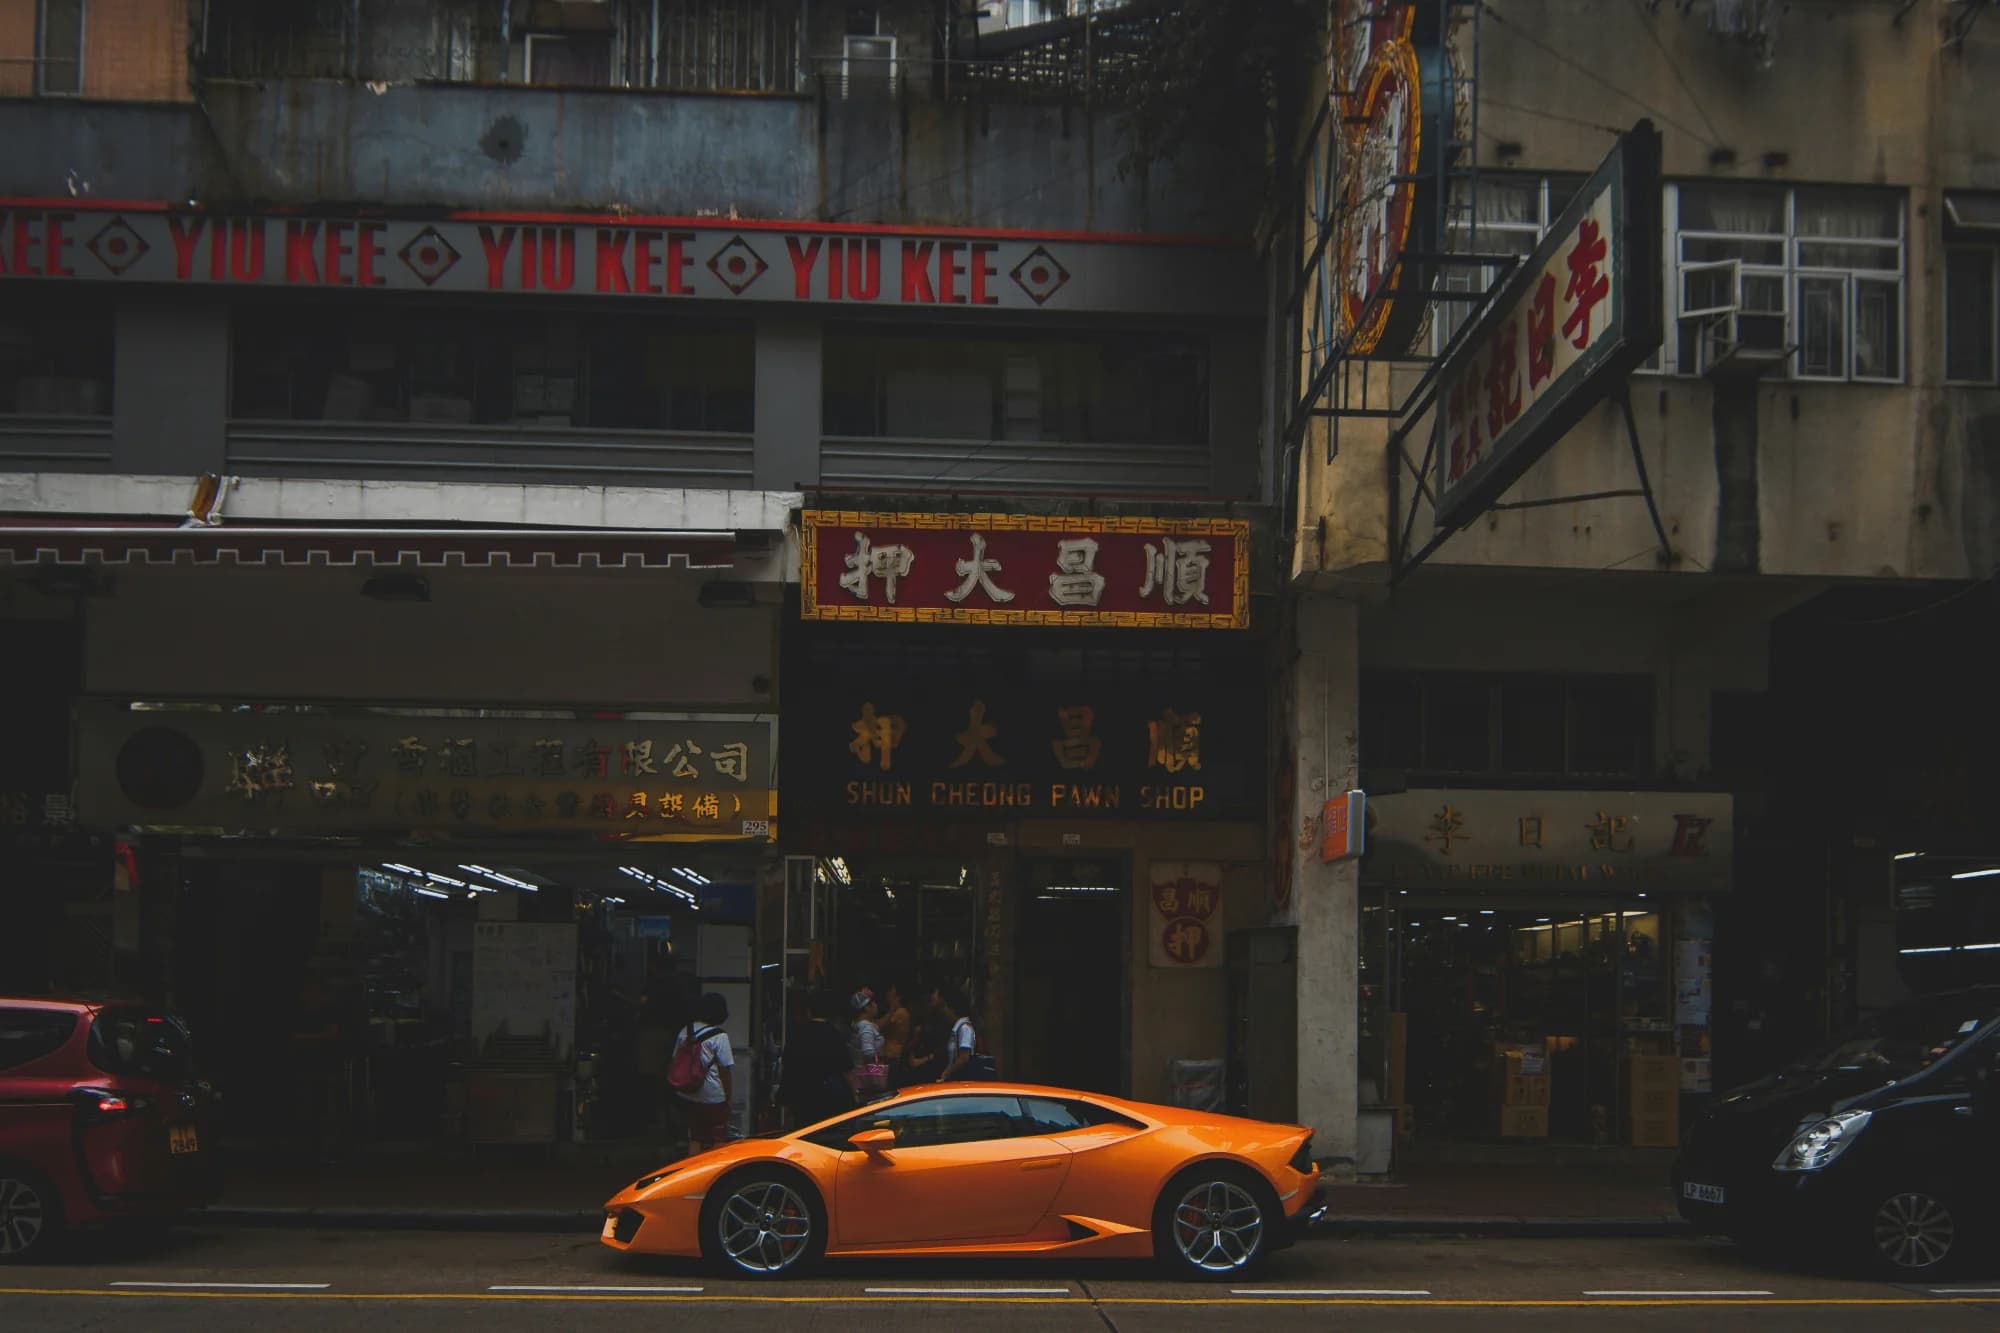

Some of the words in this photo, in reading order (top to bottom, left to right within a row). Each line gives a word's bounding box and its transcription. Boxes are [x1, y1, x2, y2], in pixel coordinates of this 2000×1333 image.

[0, 208, 77, 277] EE
[168, 215, 267, 281] YIU
[284, 218, 387, 286] KEE
[478, 224, 575, 292] YIU
[595, 229, 697, 297] KEE
[785, 234, 881, 302] YIU
[900, 239, 1000, 306] KEE
[744, 820, 768, 832] 295
[846, 780, 912, 807] SHUN
[930, 781, 1032, 808] CHEONG
[1139, 784, 1205, 811] SHOP
